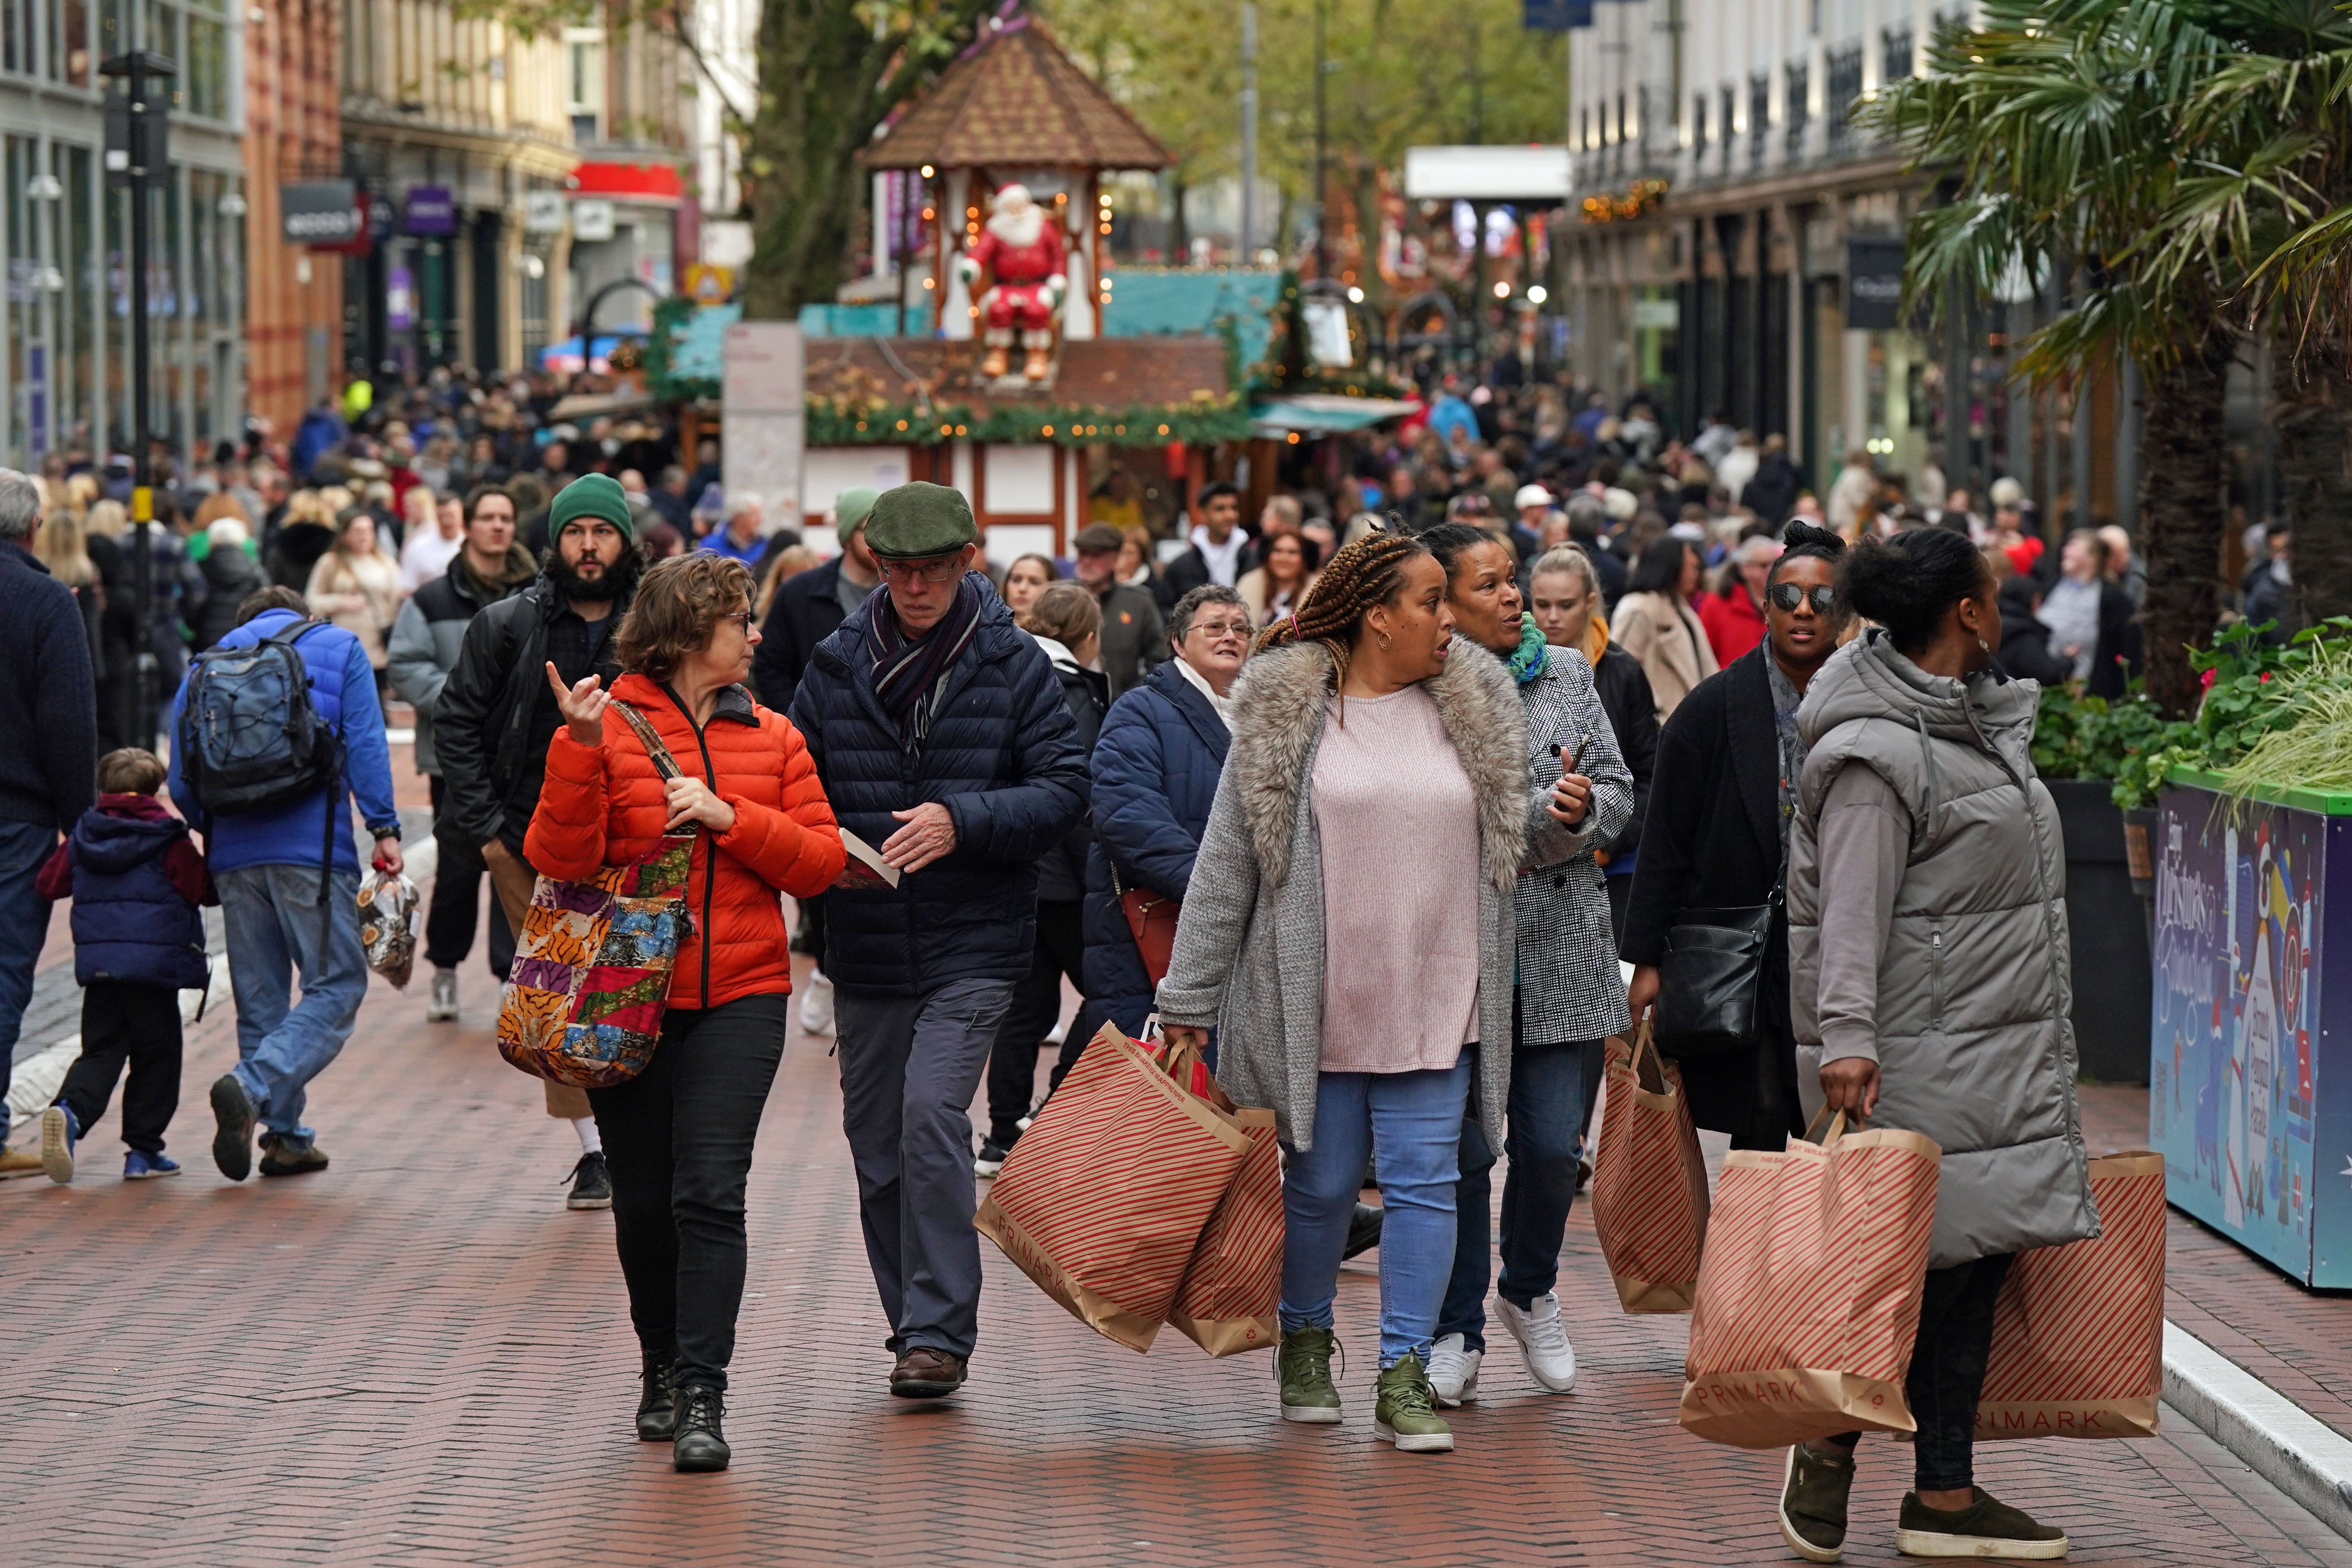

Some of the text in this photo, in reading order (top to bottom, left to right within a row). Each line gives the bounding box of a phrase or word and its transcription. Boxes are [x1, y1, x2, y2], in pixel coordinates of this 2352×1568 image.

[1123, 1042, 1136, 1054] THIS
[1173, 1089, 1185, 1103] PAPER
[998, 1215, 1064, 1297] PRIMARK
[1695, 1380, 1803, 1407] PRIMARK
[1974, 1410, 2102, 1429] RIMARK
